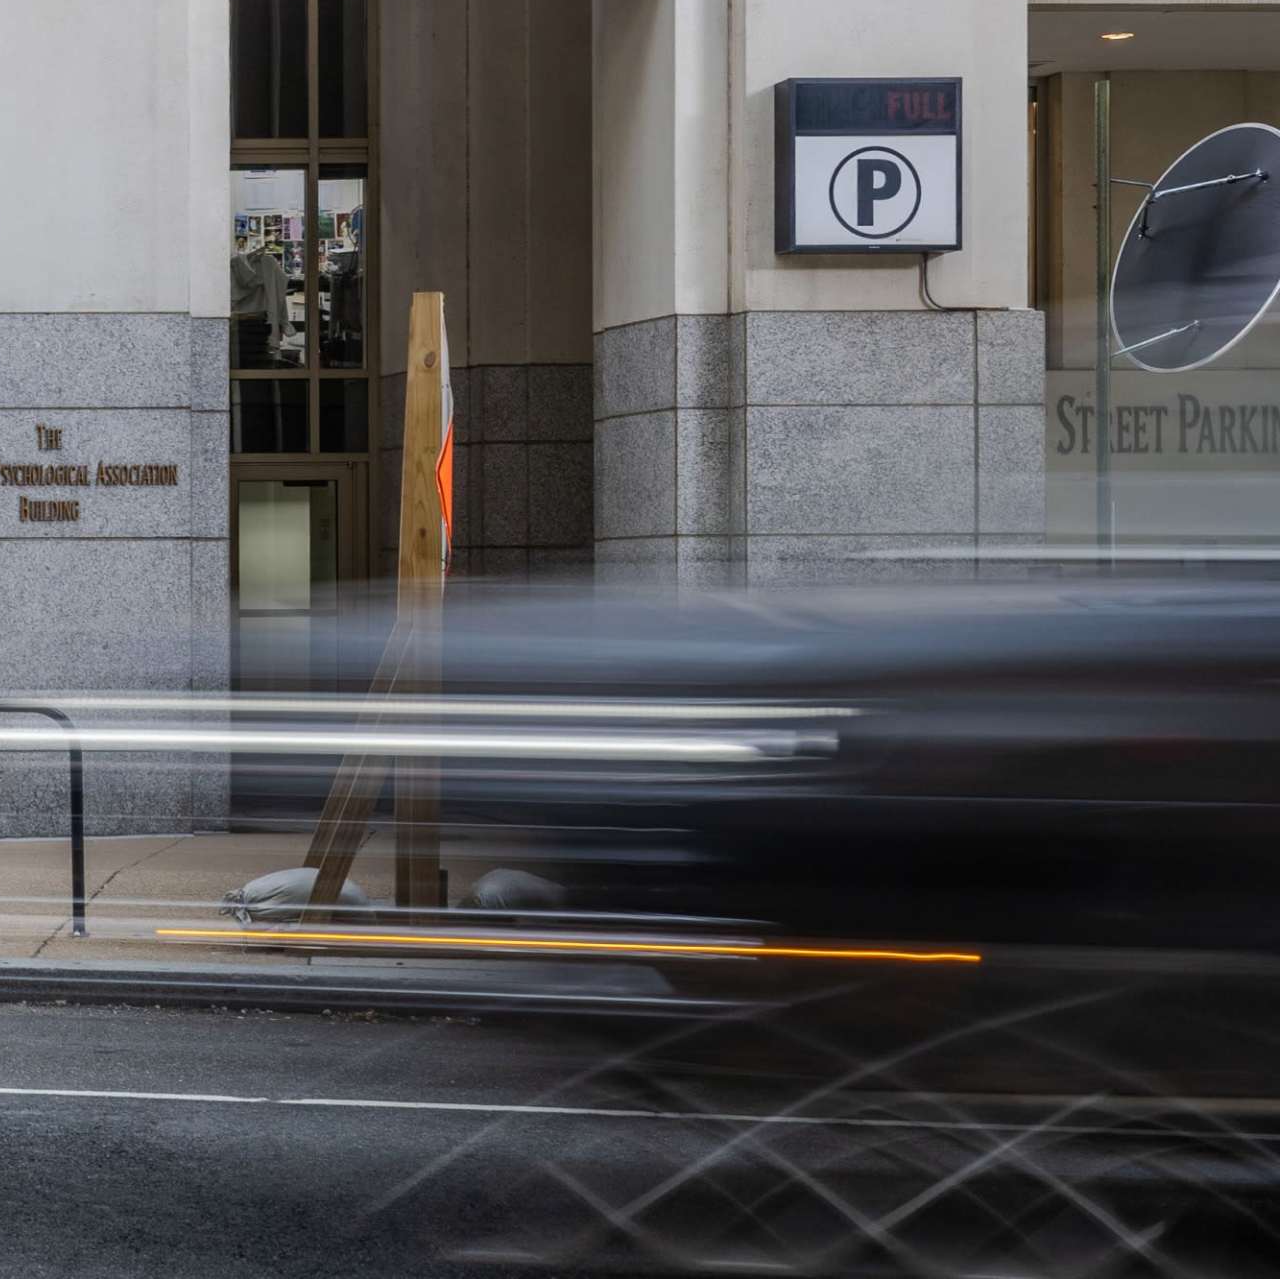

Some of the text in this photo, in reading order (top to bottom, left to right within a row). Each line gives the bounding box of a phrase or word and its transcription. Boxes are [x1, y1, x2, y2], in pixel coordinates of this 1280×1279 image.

[887, 91, 952, 120] FULL
[856, 159, 902, 227] P
[37, 424, 63, 450] THE
[1057, 394, 1168, 455] STEET
[96, 460, 179, 487] ASSOCIATION
[19, 495, 81, 523] BUILDING
